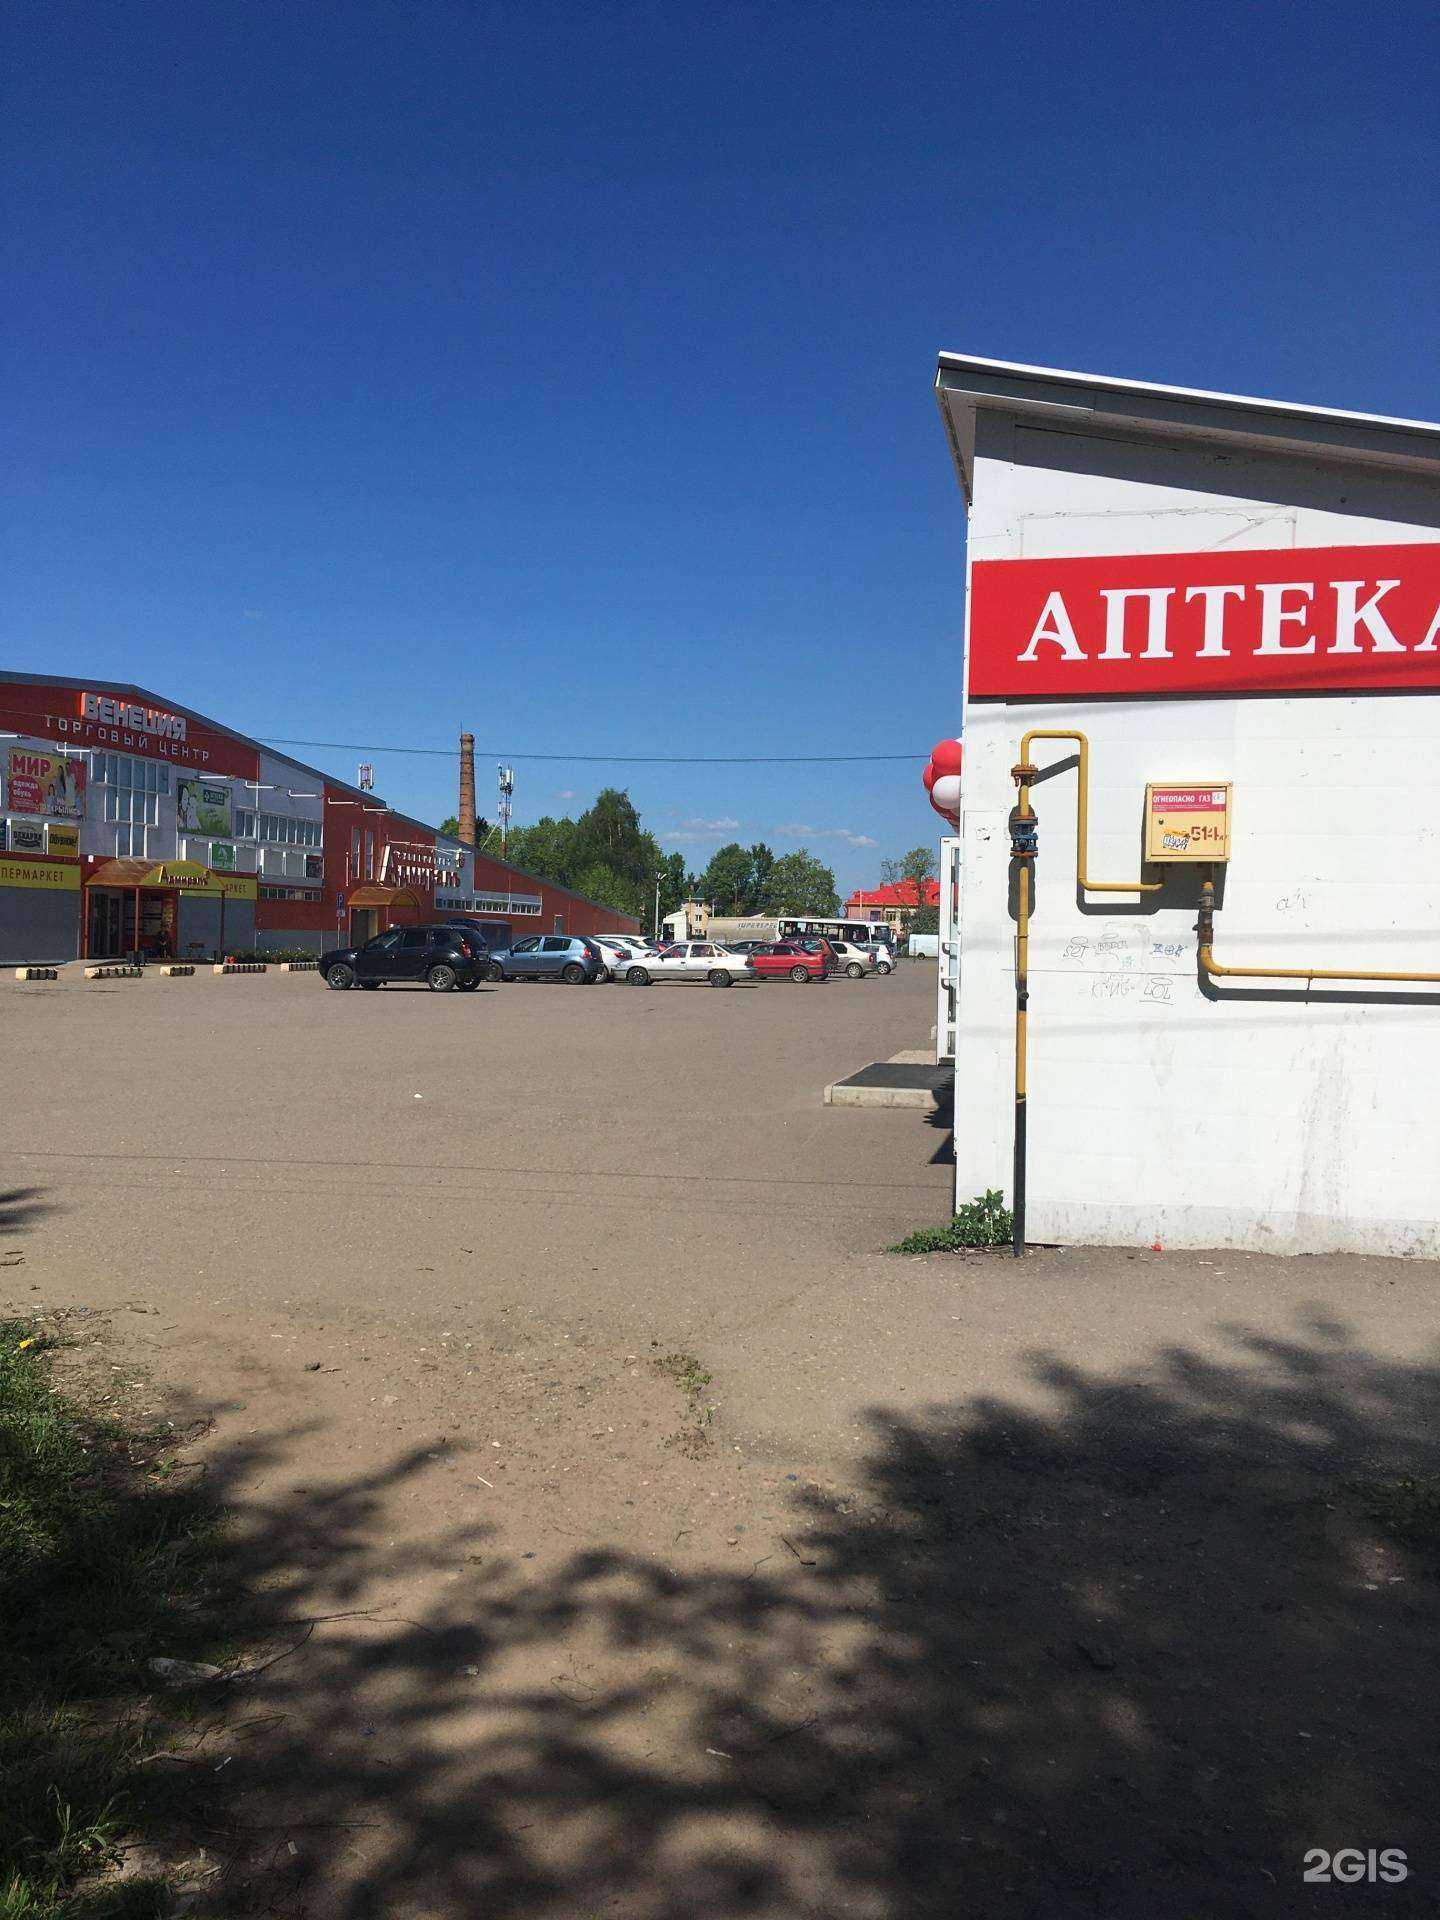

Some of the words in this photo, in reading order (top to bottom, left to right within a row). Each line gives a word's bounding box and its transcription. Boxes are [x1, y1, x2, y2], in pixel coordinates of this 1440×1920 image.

[81, 692, 187, 742] ВЕНЕЦИЯ
[45, 714, 148, 749] ТОРГОВЫЙ
[159, 741, 209, 761] ЦЕНТР
[12, 754, 52, 778] МИР
[1153, 794, 1195, 803] ОГНЕОПАСНО
[1199, 794, 1211, 803] ГАЗ
